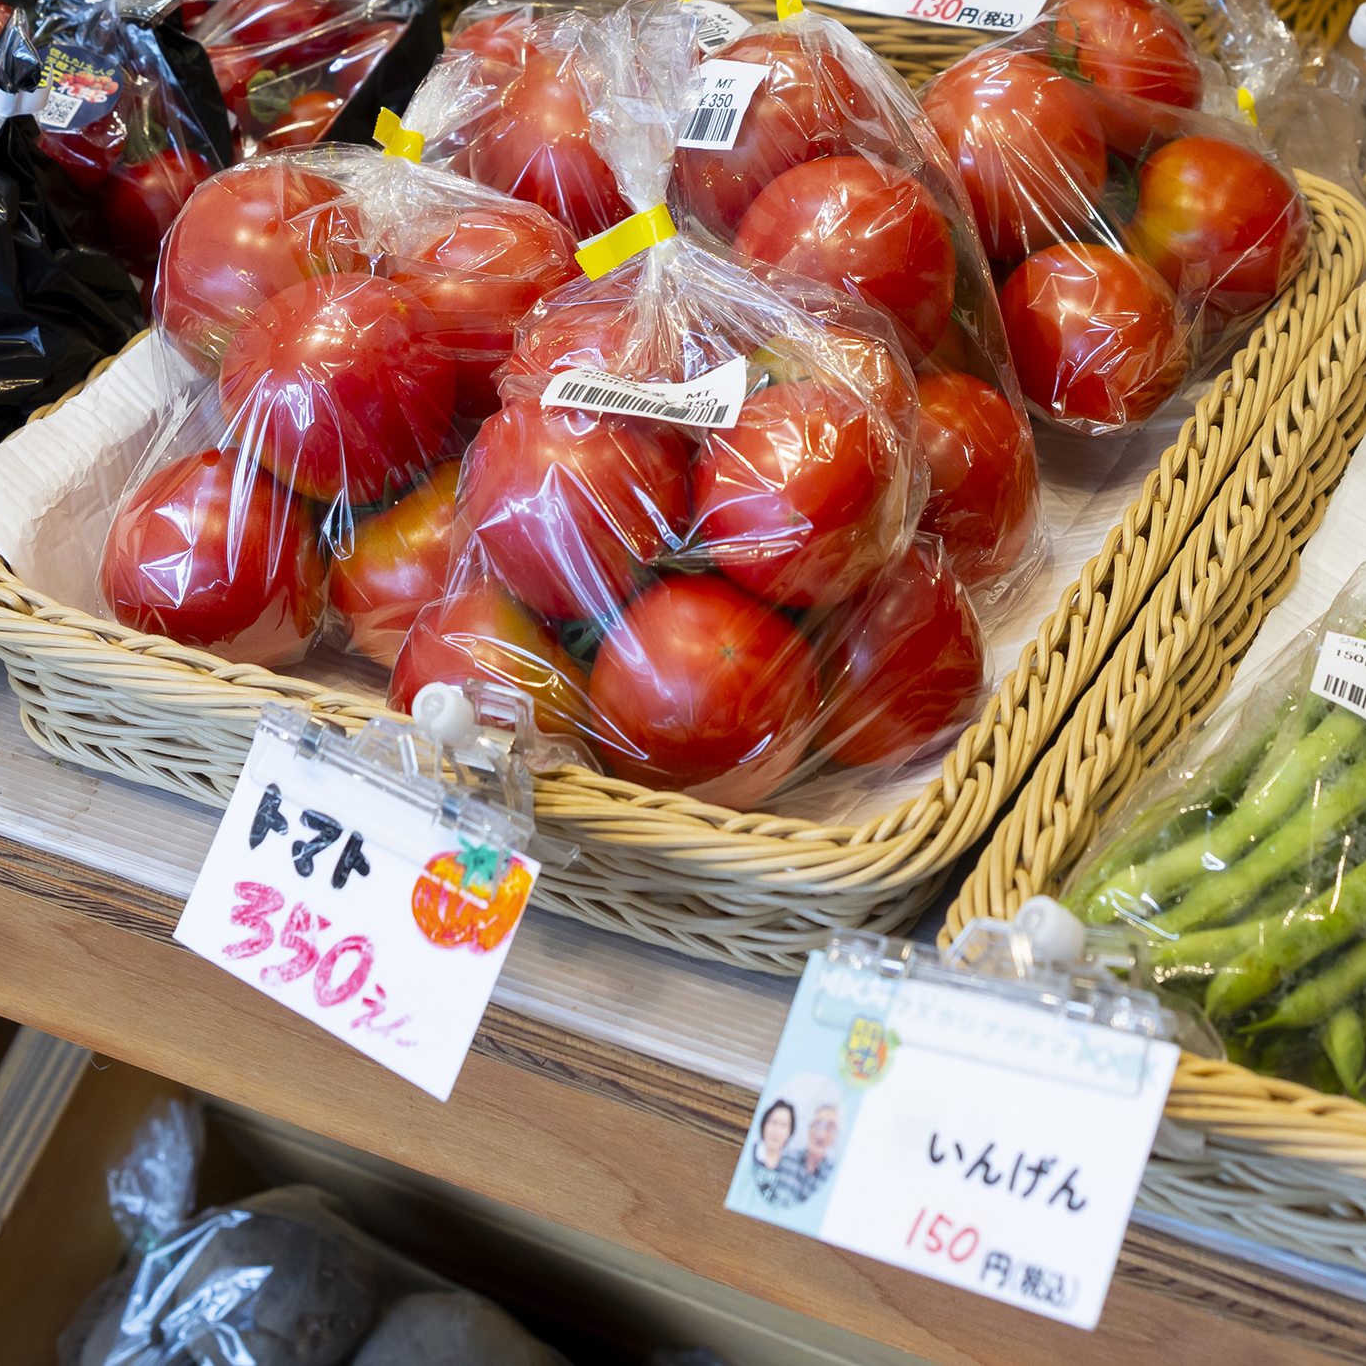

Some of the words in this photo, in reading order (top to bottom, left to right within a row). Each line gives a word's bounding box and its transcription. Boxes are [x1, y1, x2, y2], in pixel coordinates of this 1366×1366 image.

[715, 78, 737, 89] MT
[249, 782, 371, 890] トマト
[929, 1132, 1087, 1212] いんげん
[906, 1207, 1079, 1311] 150円(税込)
